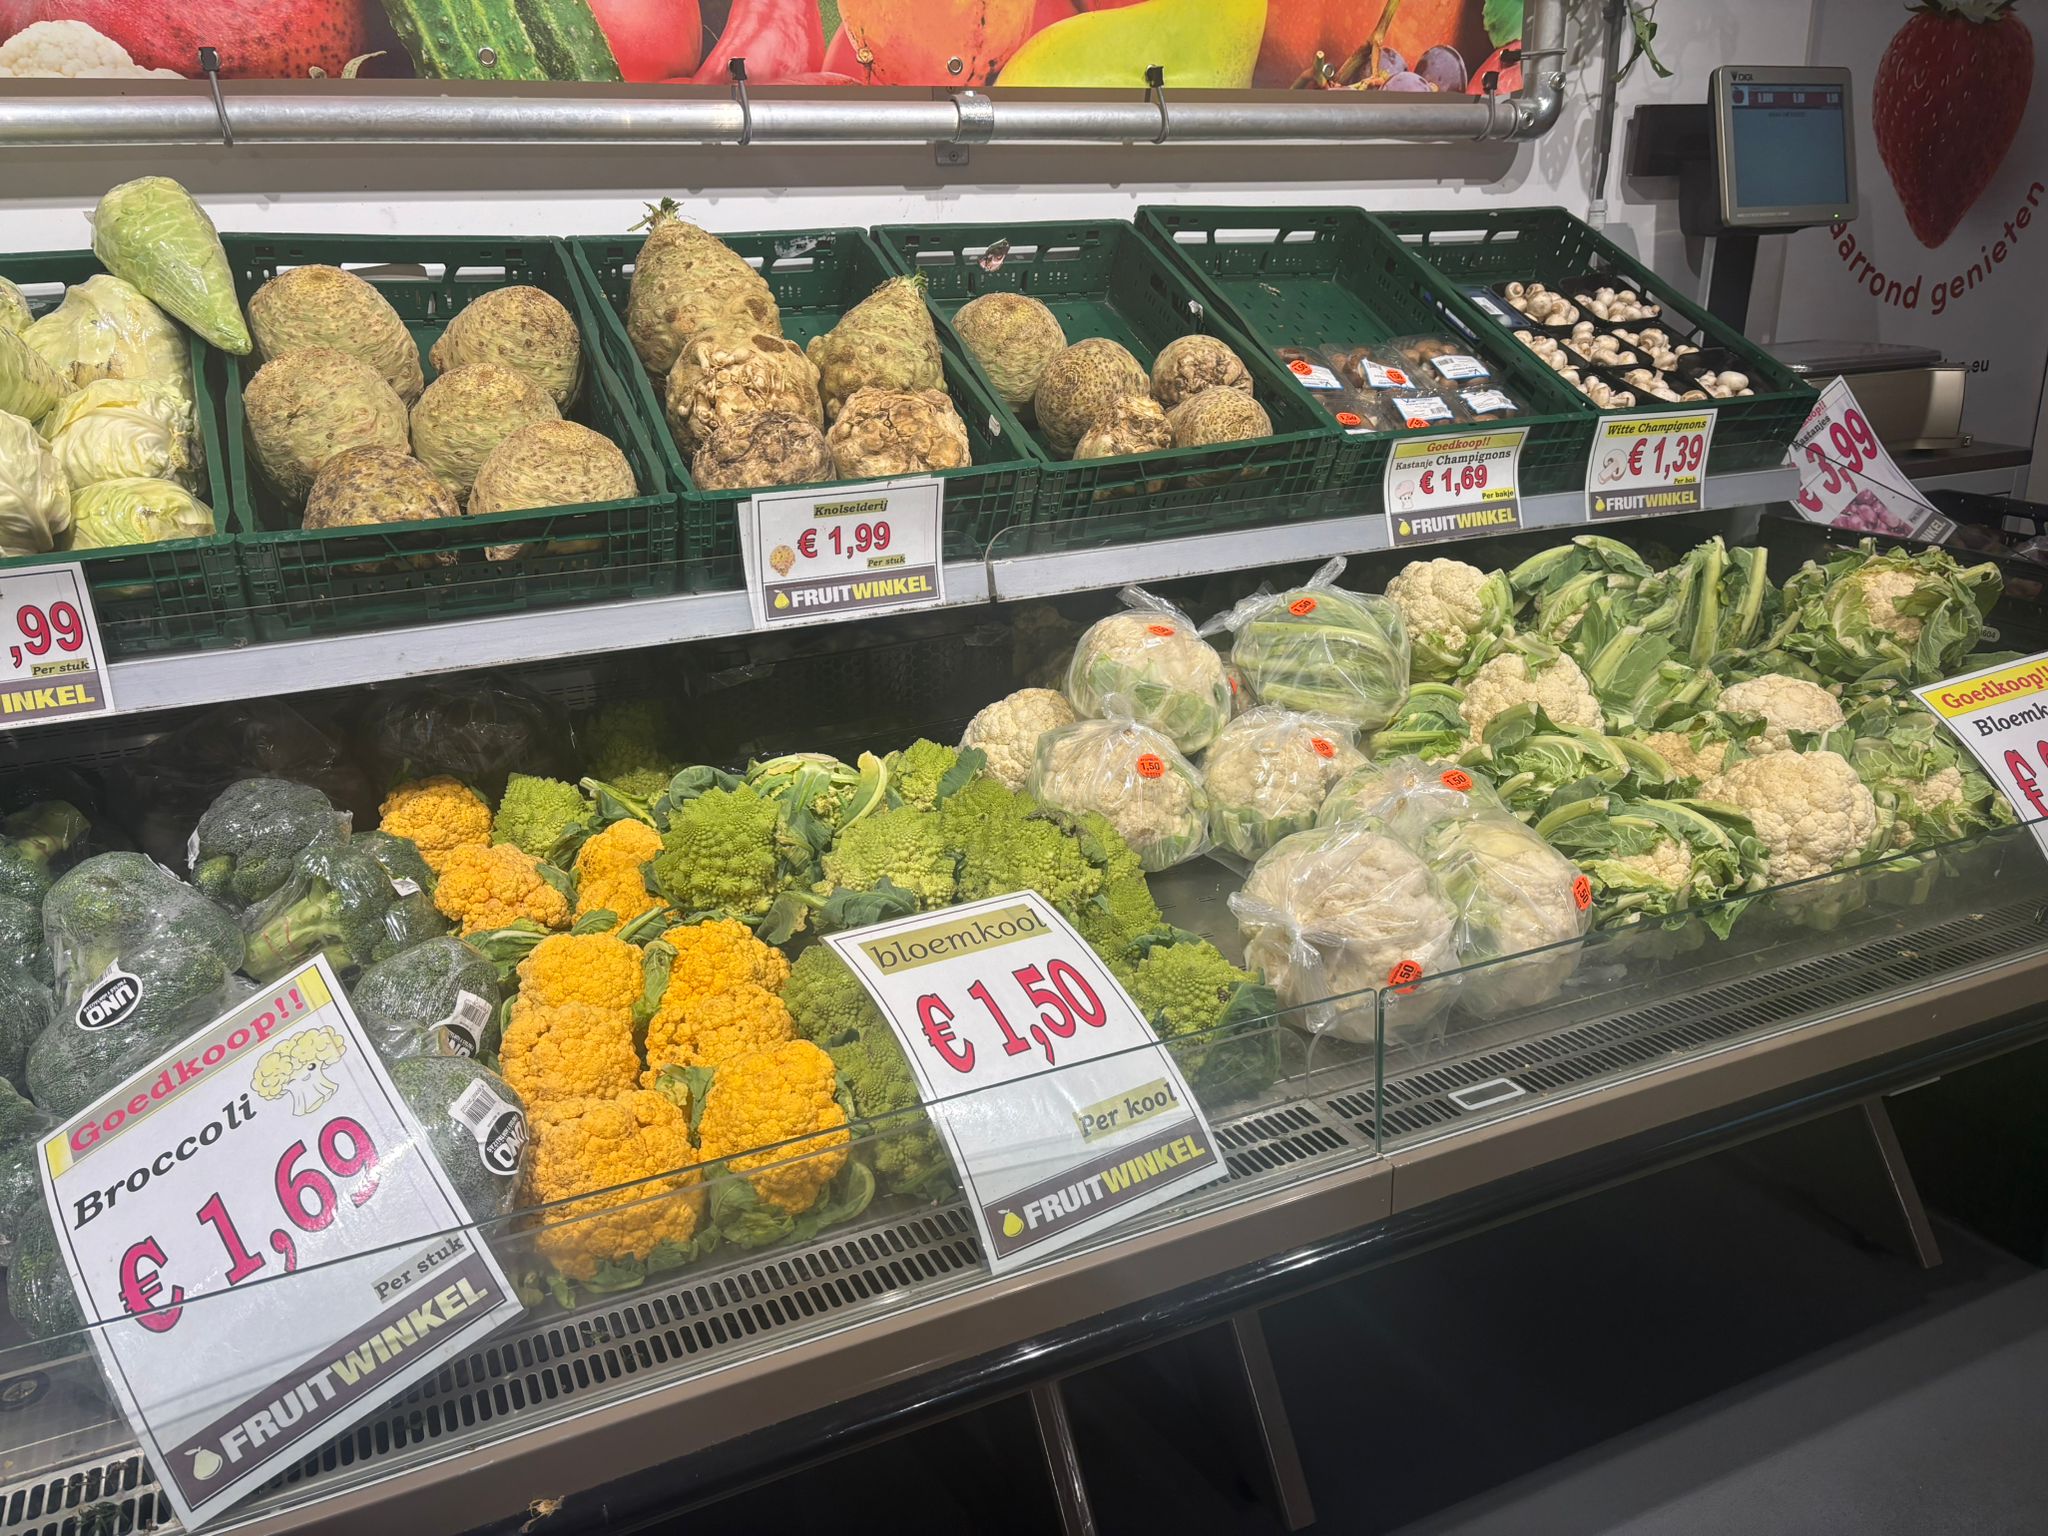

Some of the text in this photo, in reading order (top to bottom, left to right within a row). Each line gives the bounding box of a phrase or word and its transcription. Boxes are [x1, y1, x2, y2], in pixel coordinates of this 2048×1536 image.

[1931, 181, 2045, 315] genieten
[1427, 437, 1491, 453] Goedkoop!!
[1607, 420, 1707, 435] Witte Champignons
[1395, 450, 1511, 471] Kastanje Champignons
[1628, 434, 1704, 480] € 1,39
[1806, 409, 1878, 494] 3,99
[1419, 464, 1488, 497] € 1,69
[1482, 489, 1514, 500] Per bakje
[814, 500, 888, 517] Knolselderij
[1606, 490, 1697, 511] FRUITWINKEL
[1411, 507, 1516, 536] FRUITWINKEL
[797, 521, 891, 560] € 1,99
[868, 555, 906, 568] Per stuk
[791, 575, 932, 608] FRUITWINKEL
[32, 660, 90, 676] Per stuk
[0, 684, 95, 714] INKEL
[1140, 761, 1160, 771] 1,50
[1446, 774, 1467, 785] 1,50
[1576, 881, 1589, 903] 1,50
[869, 908, 1047, 969] bloemkool
[86, 984, 135, 1025] UNO
[917, 958, 1107, 1073] € 1,50
[70, 987, 305, 1152] Goedkoop!!
[1078, 1082, 1178, 1139] Per kool
[73, 1093, 257, 1231] Broccoli
[493, 1120, 526, 1168] UNO
[1022, 1135, 1206, 1230] FRUITWINKEL
[119, 1116, 381, 1333] € 1,69
[374, 1235, 465, 1301] Per stuk
[219, 1278, 488, 1464] FRUITWINKEL
